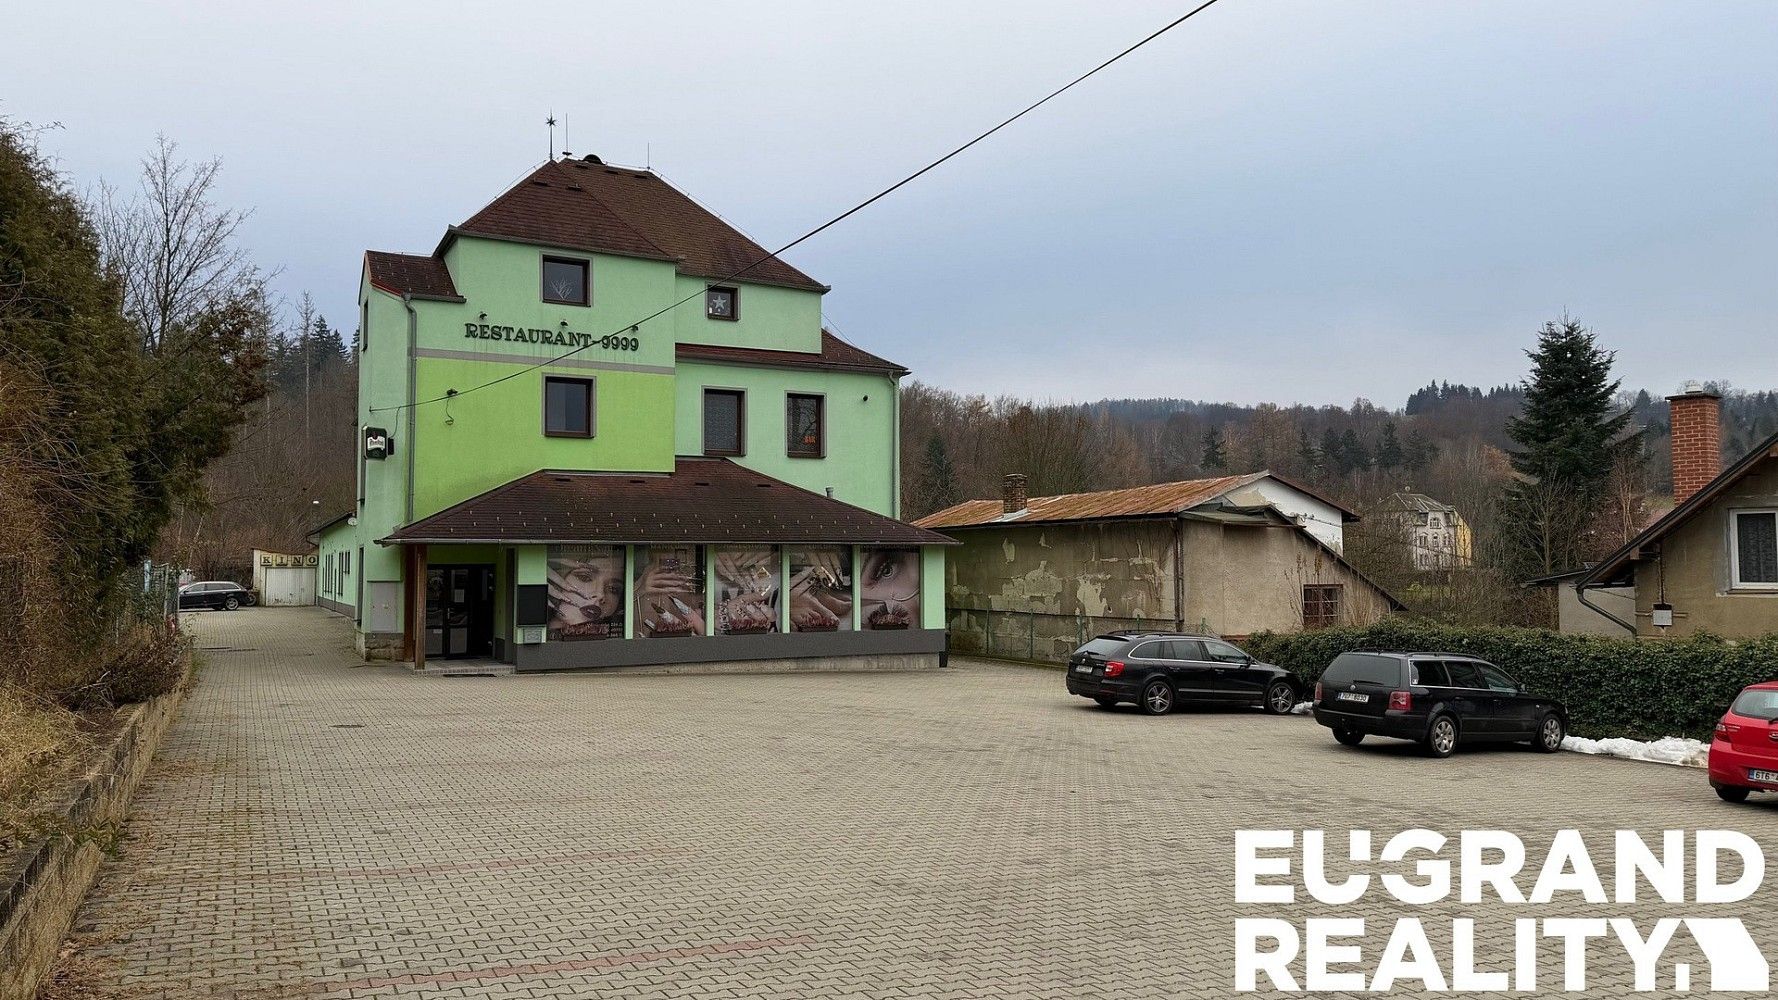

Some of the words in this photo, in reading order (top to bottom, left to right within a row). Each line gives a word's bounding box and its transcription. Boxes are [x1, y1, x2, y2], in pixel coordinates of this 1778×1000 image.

[464, 322, 592, 348] RESTAURANT
[262, 556, 316, 564] KINO
[1755, 771, 1770, 780] 6T6
